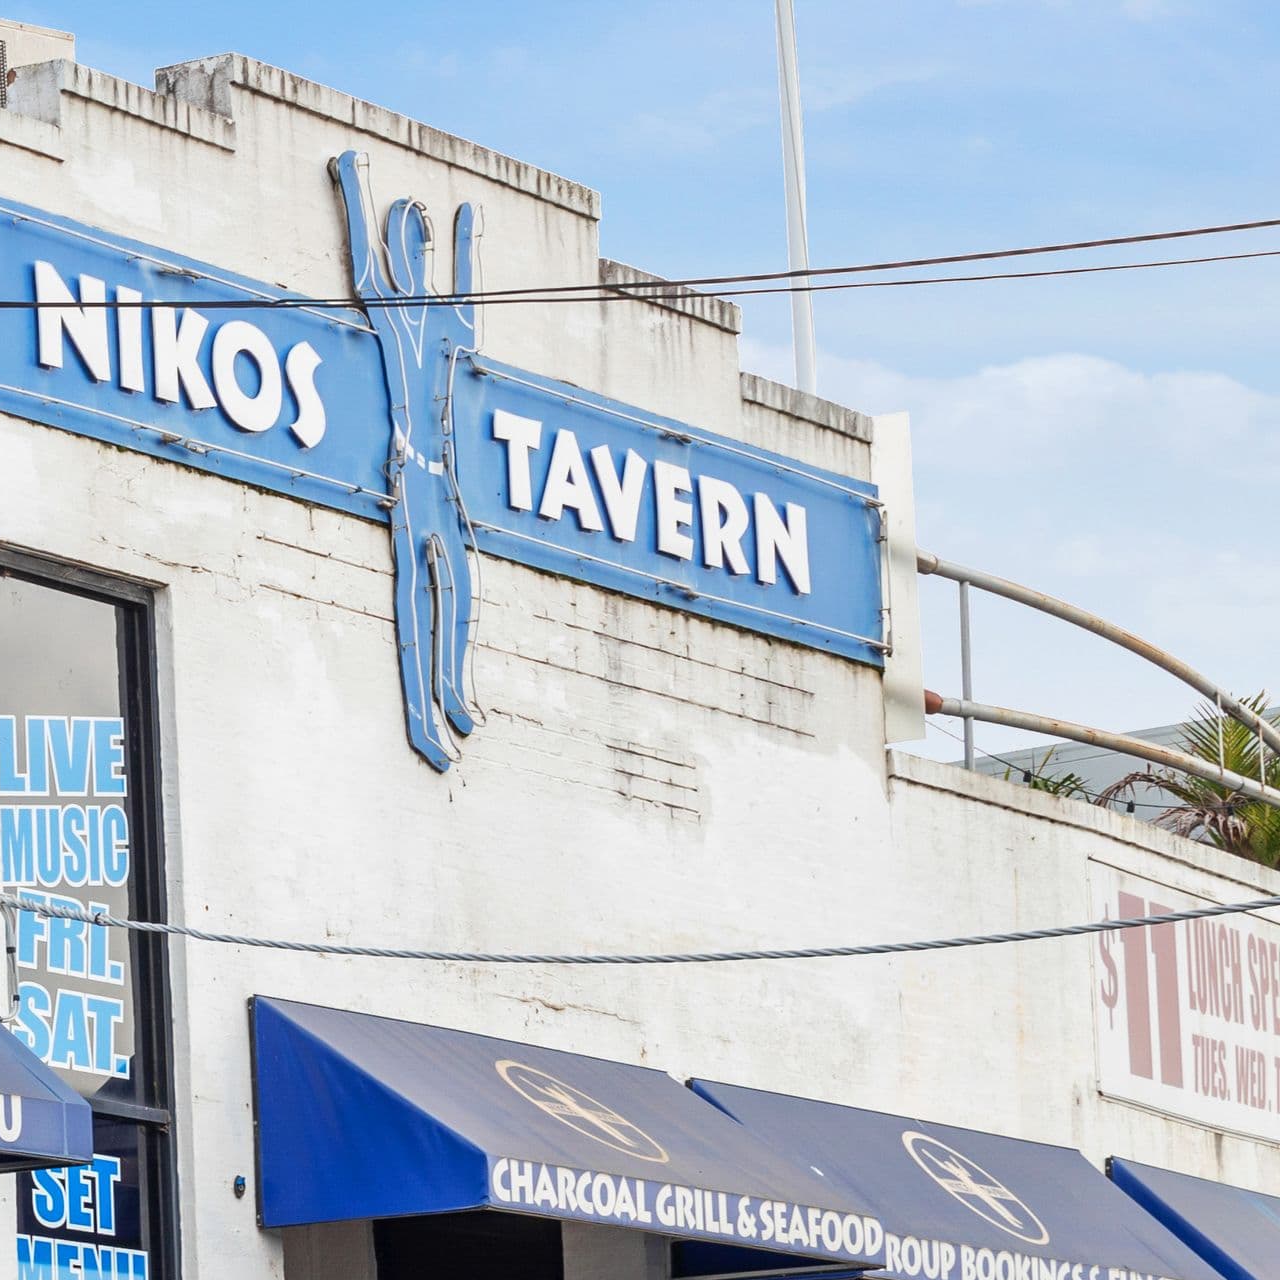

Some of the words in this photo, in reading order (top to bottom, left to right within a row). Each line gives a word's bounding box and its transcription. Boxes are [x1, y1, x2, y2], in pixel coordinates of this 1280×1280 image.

[34, 260, 326, 449] NIKOS
[493, 408, 811, 595] TAVERN
[0, 804, 129, 887] MUSIC
[16, 887, 124, 985] FRI.
[1185, 918, 1244, 1025] LUNCH
[1247, 932, 1280, 1036] SPE
[12, 981, 130, 1080] SAT.
[31, 1153, 120, 1236] SET
[492, 1157, 652, 1223] CHARCOAL
[655, 1184, 734, 1235] GRILL
[737, 1195, 757, 1238] &
[760, 1199, 884, 1257] SEAFOOD
[885, 1232, 955, 1280] ROUP
